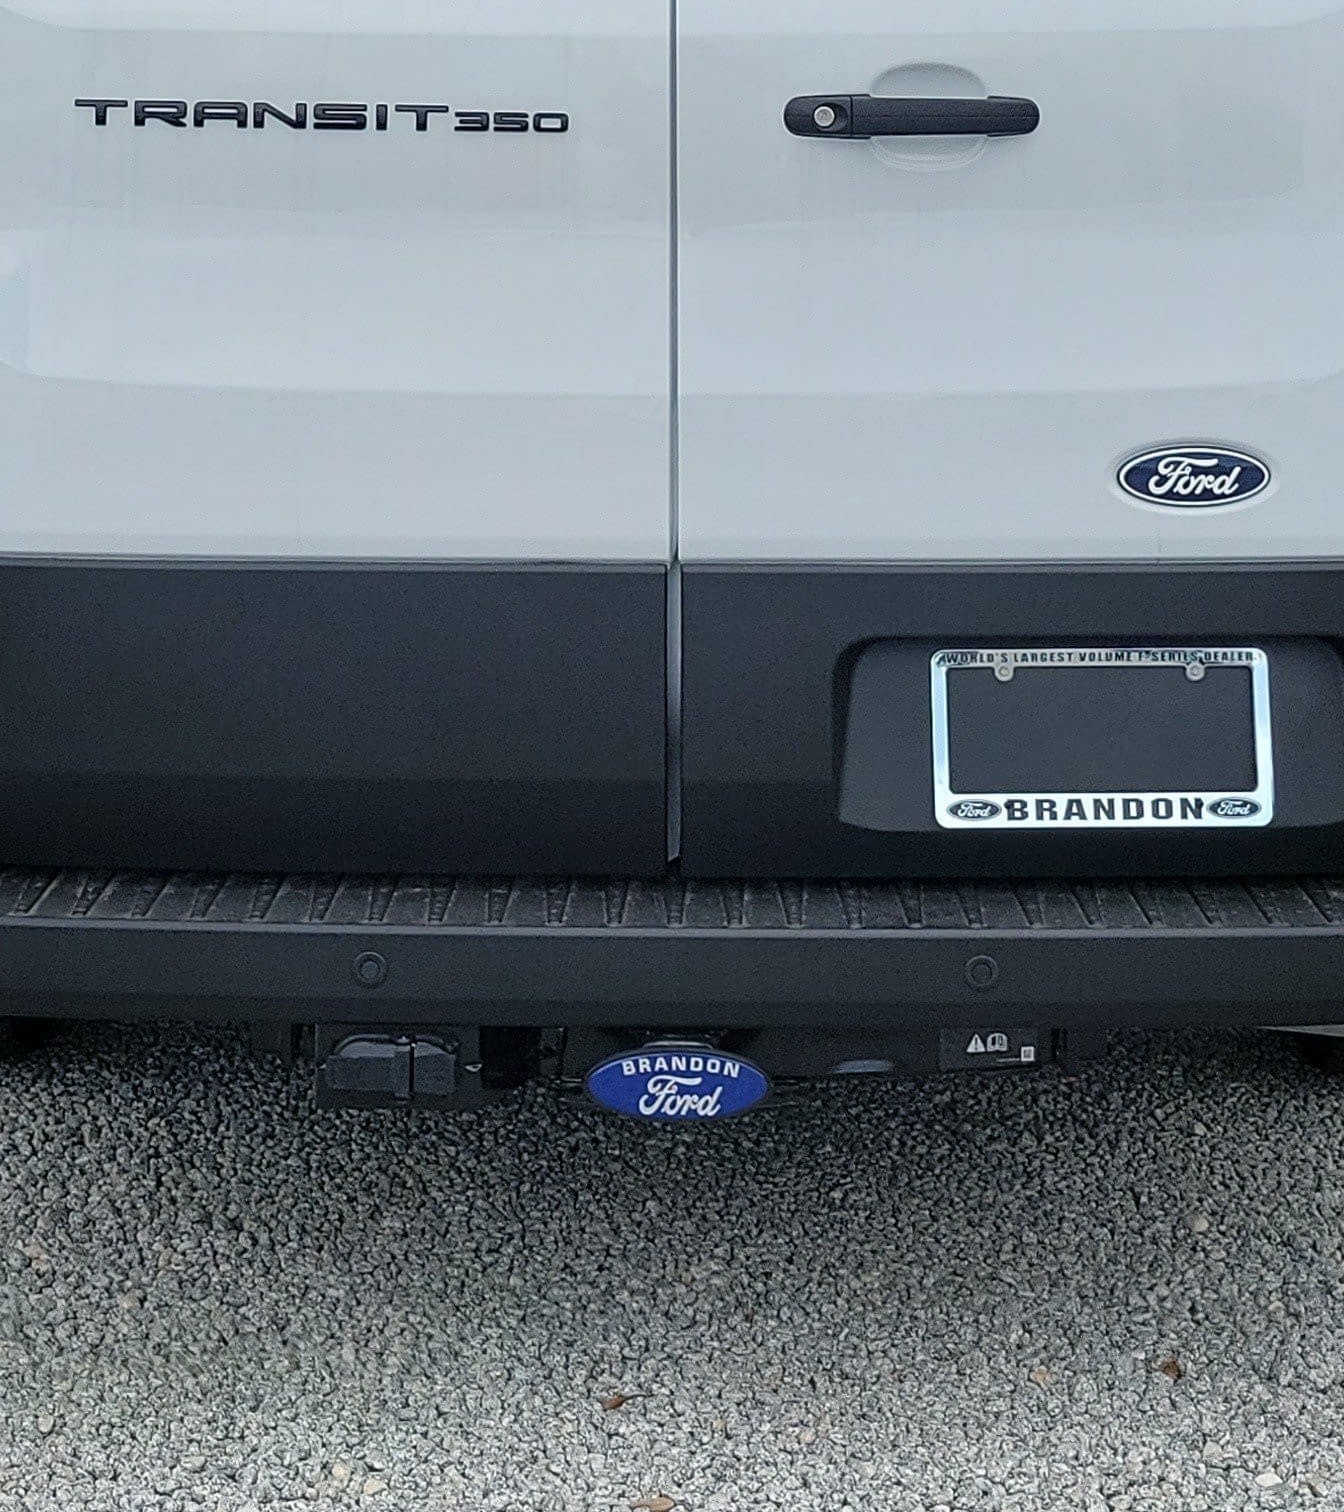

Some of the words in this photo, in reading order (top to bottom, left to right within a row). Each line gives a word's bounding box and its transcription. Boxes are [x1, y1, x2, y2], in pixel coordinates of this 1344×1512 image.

[1148, 456, 1242, 496] Ford
[1014, 651, 1073, 663] LARGEST
[1079, 651, 1135, 663] VOLUME
[1206, 650, 1254, 662] DEALER
[957, 801, 992, 818] Ford
[1006, 797, 1204, 821] BRANDON
[1217, 799, 1252, 816] Ford
[621, 1055, 741, 1078] BRANDON
[638, 1074, 724, 1117] Ford
